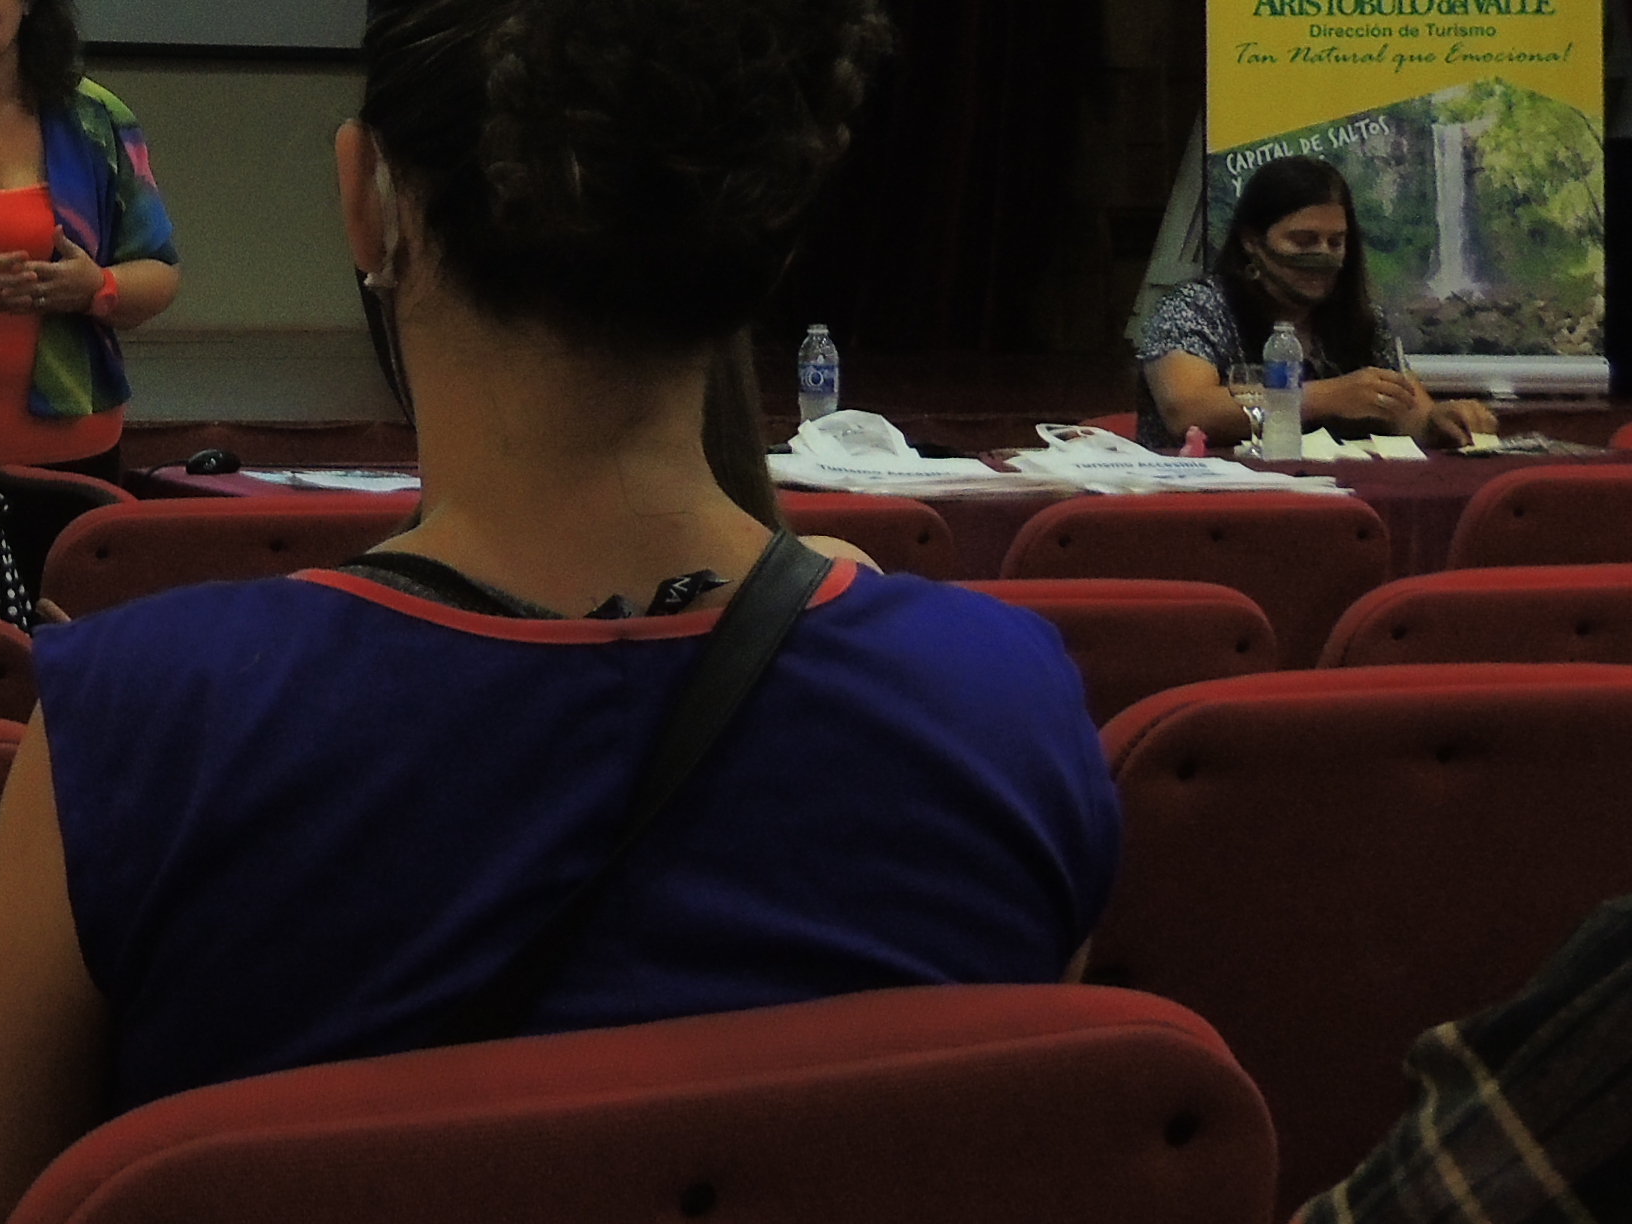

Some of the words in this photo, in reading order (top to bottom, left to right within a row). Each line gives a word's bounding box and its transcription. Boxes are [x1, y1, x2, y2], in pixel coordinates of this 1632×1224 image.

[1309, 22, 1393, 39] Dirección
[1398, 22, 1420, 39] de
[1426, 22, 1497, 39] Turismo
[1235, 41, 1278, 65] Tan
[1287, 42, 1390, 65] Natural
[1391, 50, 1437, 74] que
[1443, 40, 1574, 65] Emociona!
[1226, 141, 1294, 176] CAPITAL
[1299, 133, 1324, 154] DE
[1327, 114, 1392, 149] SALTOS
[1231, 176, 1243, 198] Y
